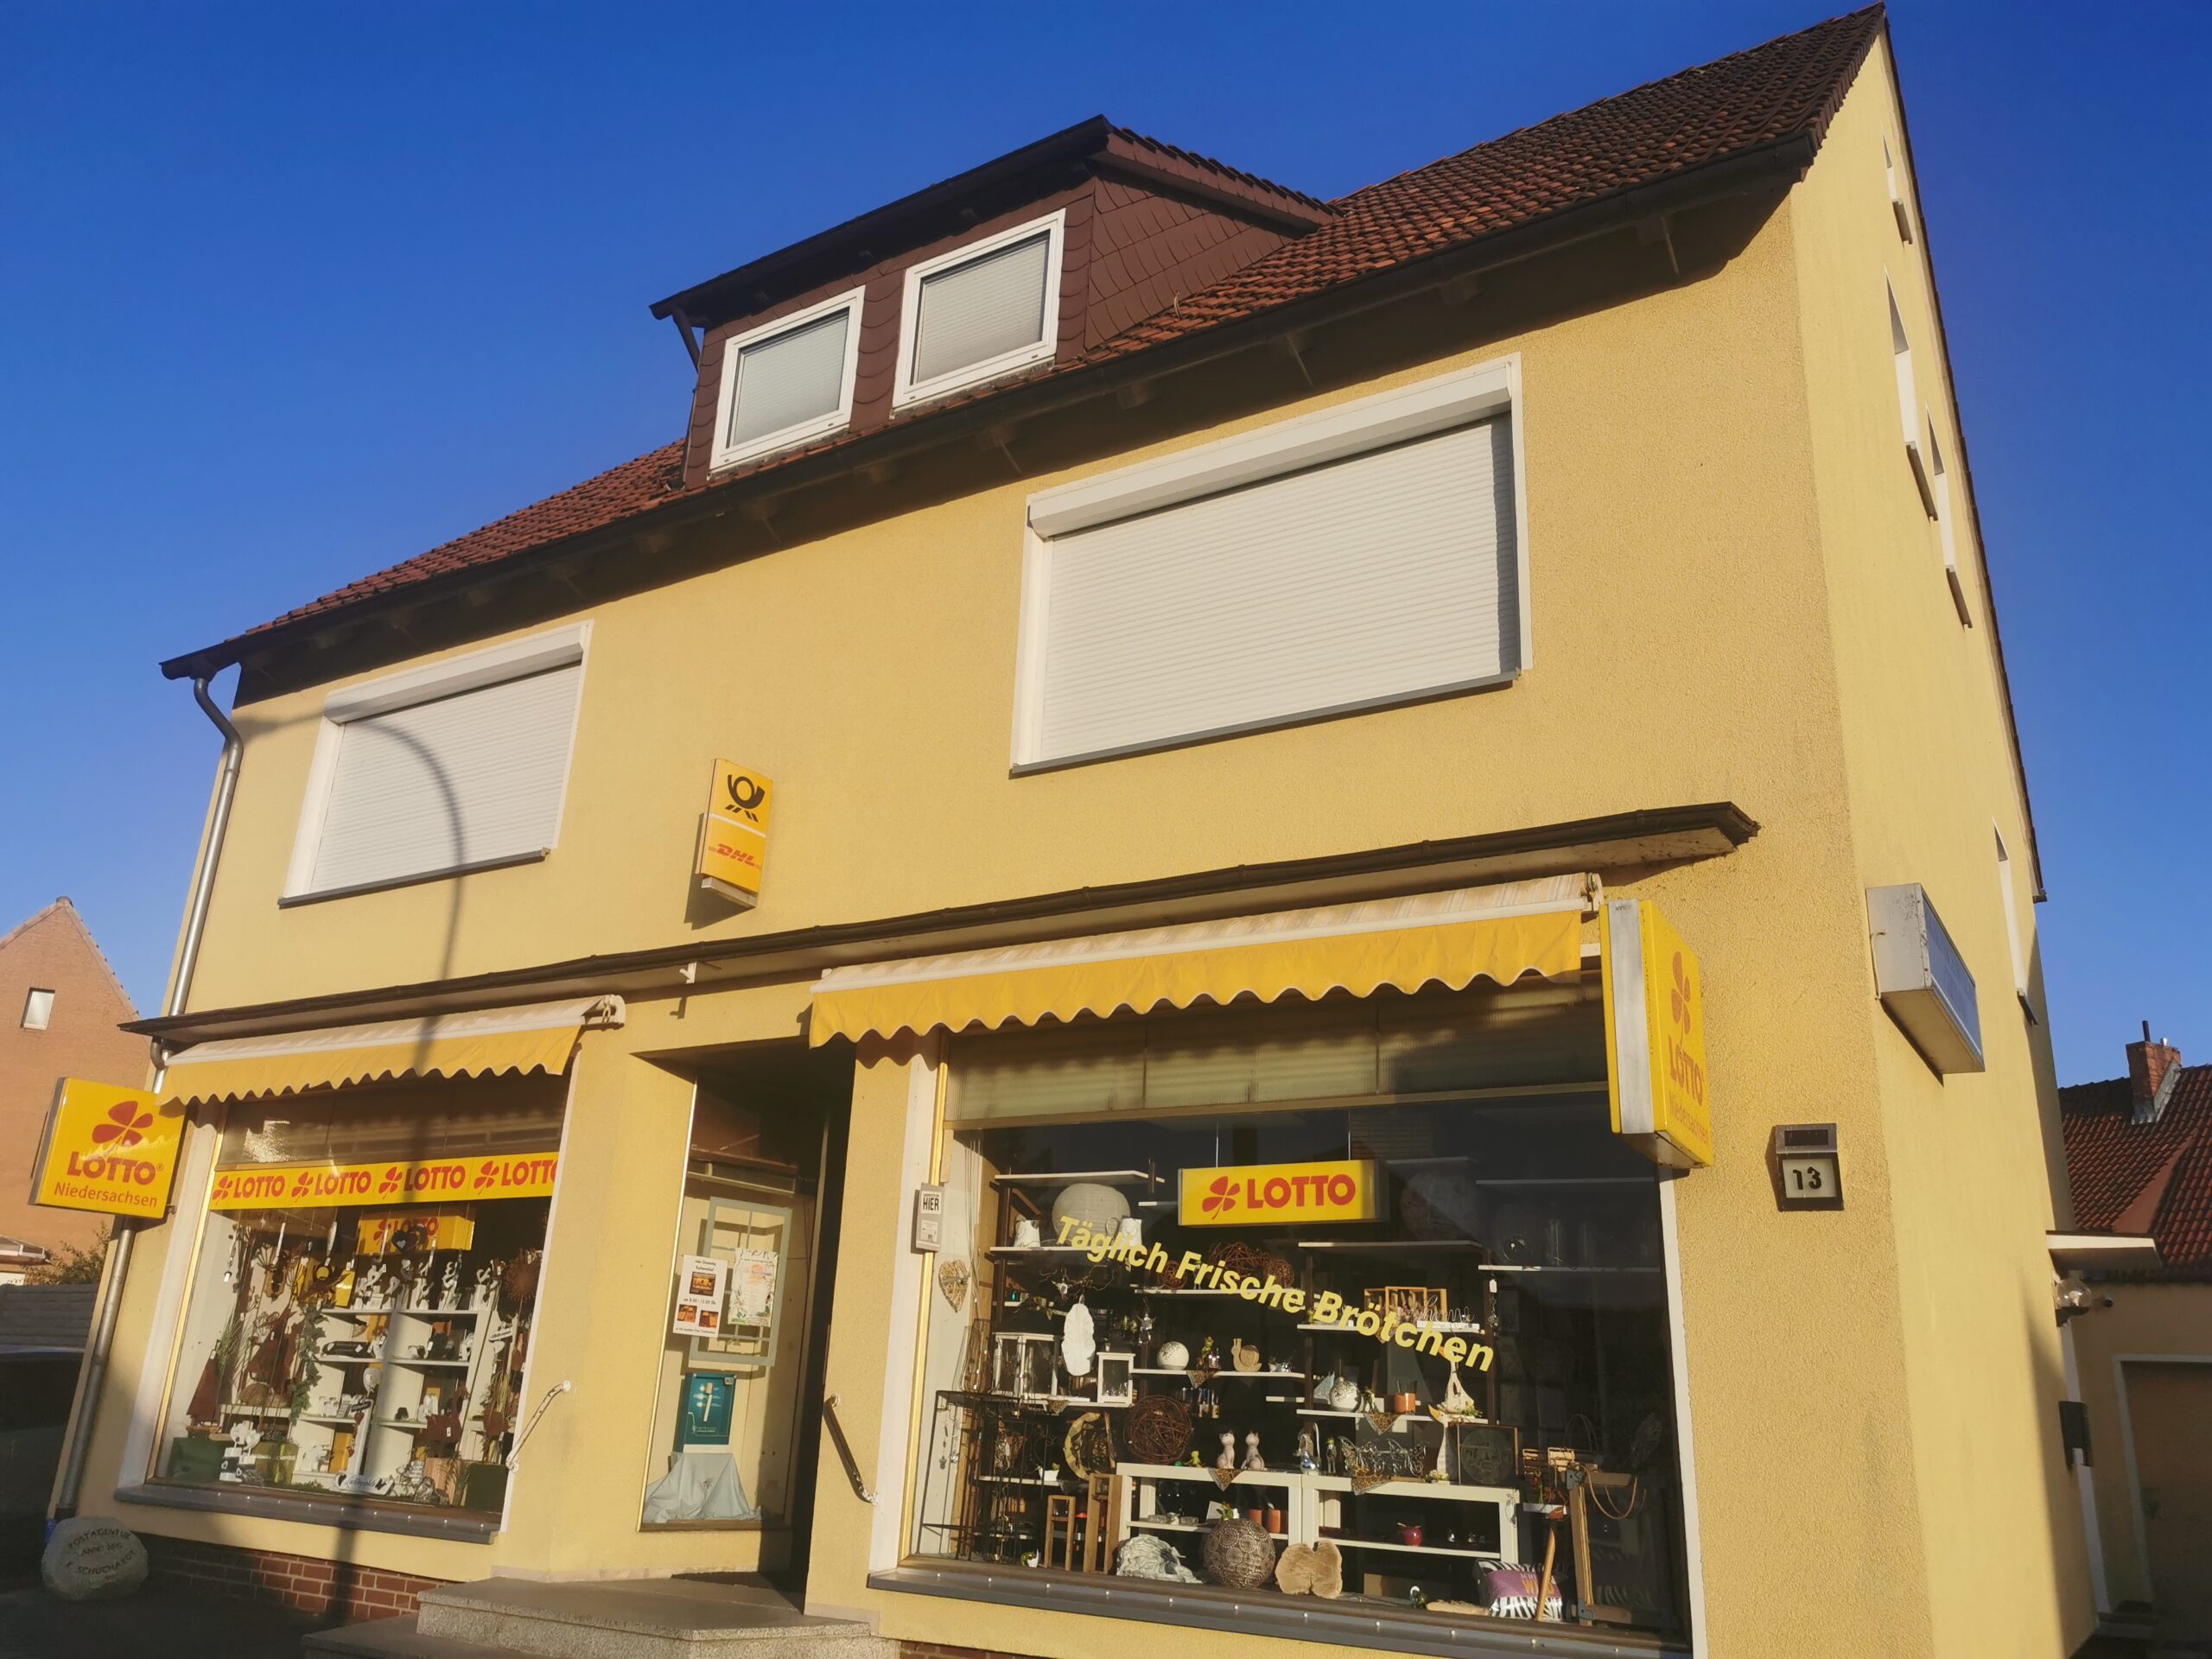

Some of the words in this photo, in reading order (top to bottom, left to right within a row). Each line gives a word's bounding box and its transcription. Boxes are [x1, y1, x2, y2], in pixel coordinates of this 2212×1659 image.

[716, 843, 756, 867] DHL
[1669, 1035, 1703, 1107] LOTTO
[67, 1151, 156, 1185] LOTTO
[233, 1175, 286, 1198] LOTTO
[315, 1171, 372, 1196] LOTTO
[404, 1165, 466, 1191] LOTTO
[1792, 1166, 1821, 1190] 13
[54, 1181, 158, 1208] Niedersachsen
[923, 1197, 939, 1211] HIER
[1247, 1173, 1356, 1209] LOTTO
[1057, 1216, 1168, 1274] Täglich
[1174, 1250, 1306, 1313] Frische
[1313, 1291, 1494, 1372] Brötchen
